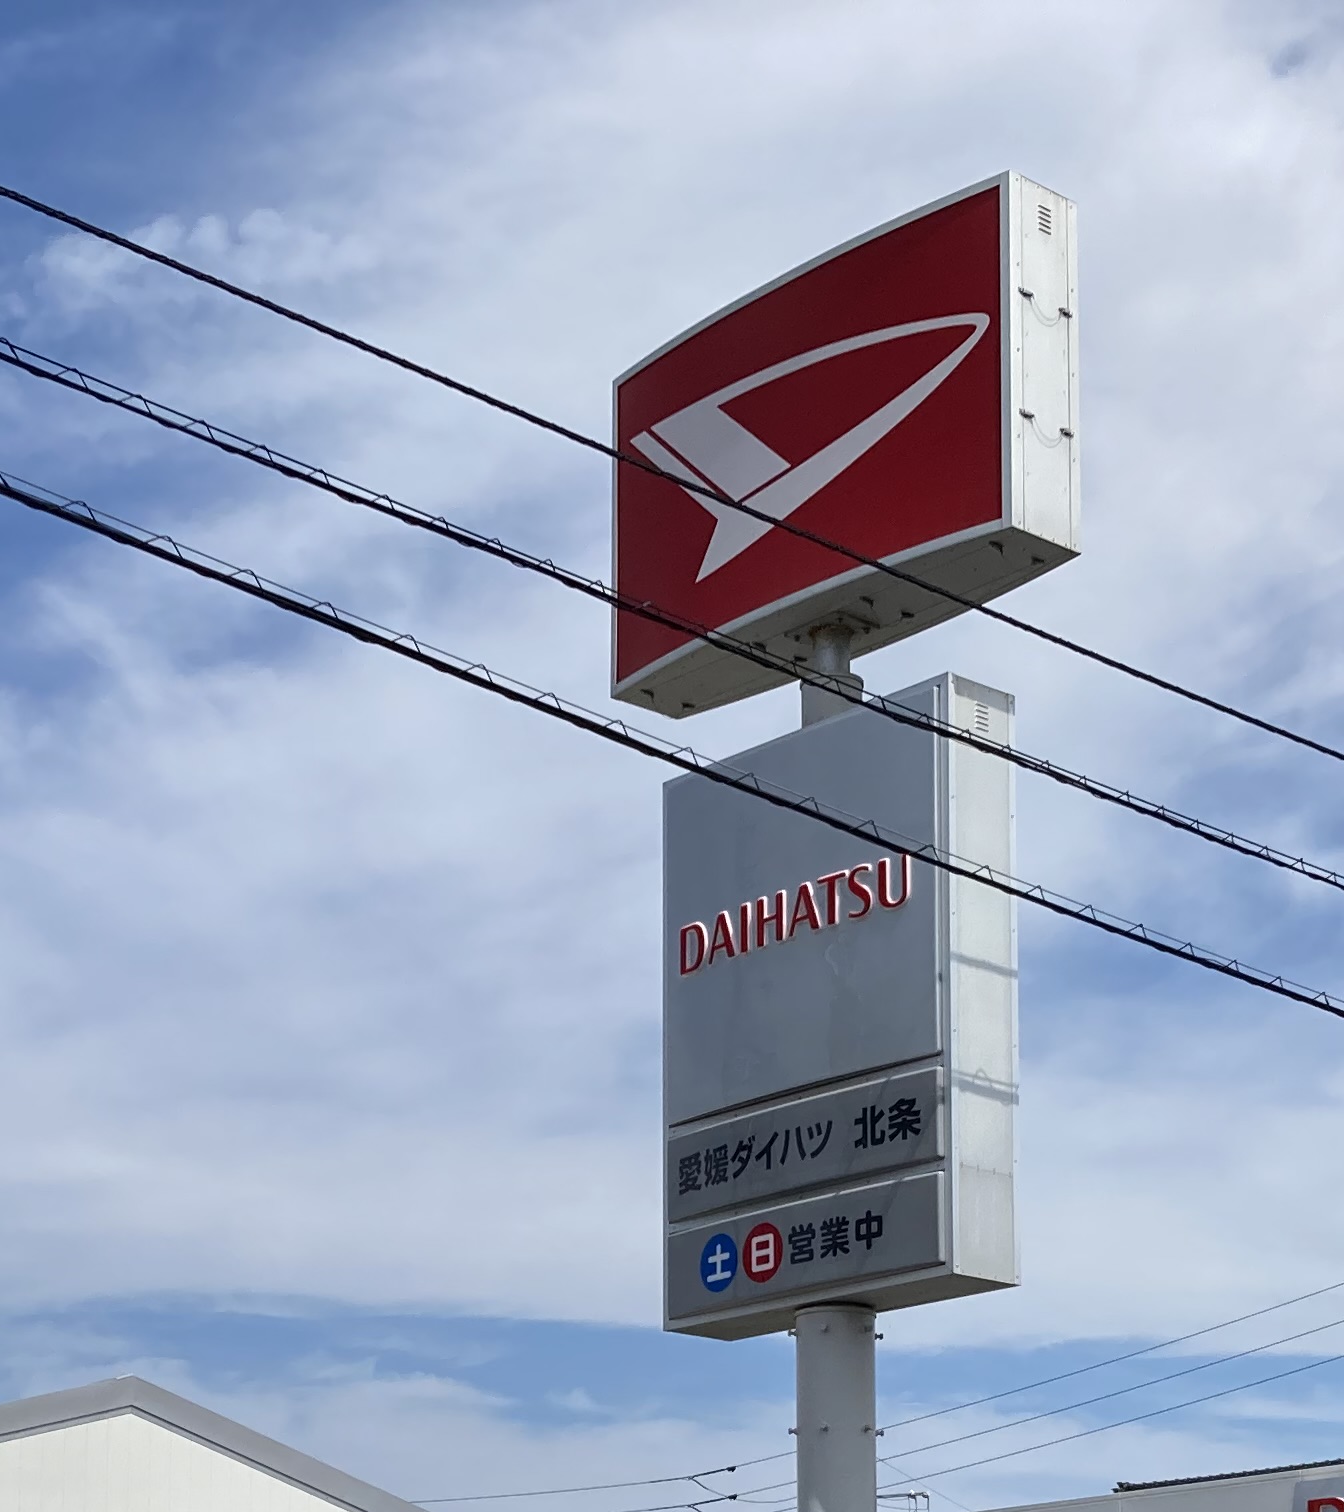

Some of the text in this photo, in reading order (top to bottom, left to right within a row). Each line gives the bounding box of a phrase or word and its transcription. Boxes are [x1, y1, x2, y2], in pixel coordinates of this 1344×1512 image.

[679, 854, 912, 976] DAIHATSU
[678, 1097, 923, 1196] 愛媛ダイハツ 北条
